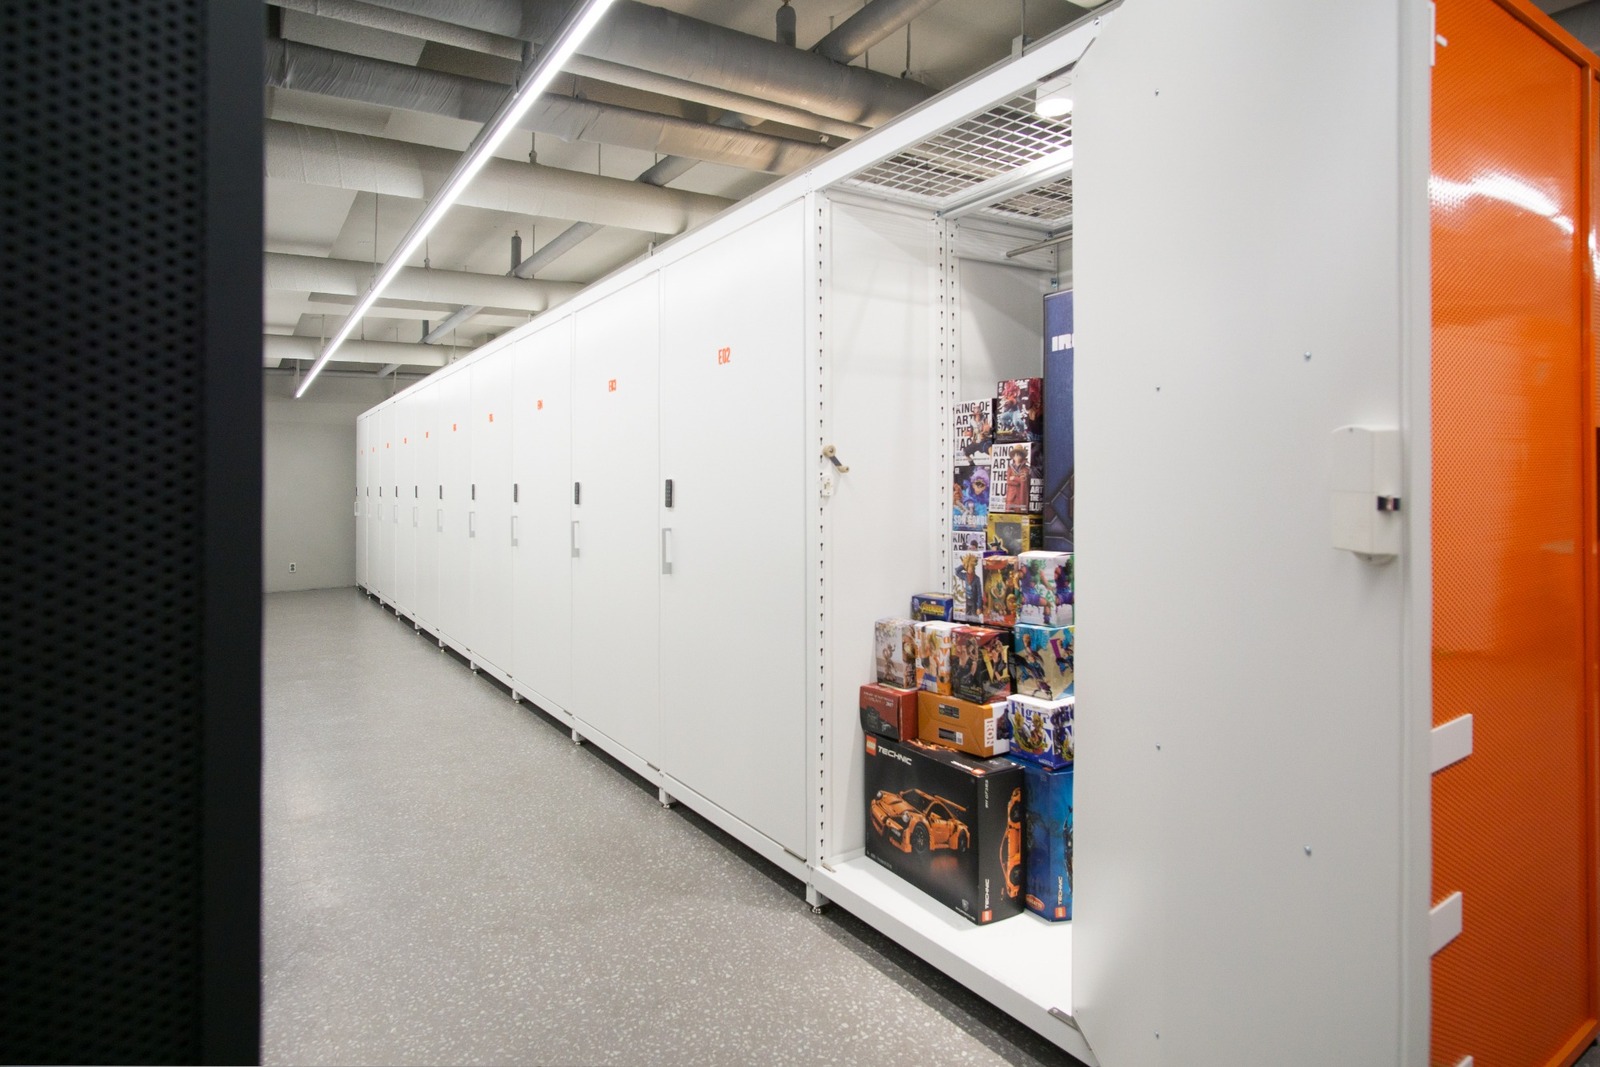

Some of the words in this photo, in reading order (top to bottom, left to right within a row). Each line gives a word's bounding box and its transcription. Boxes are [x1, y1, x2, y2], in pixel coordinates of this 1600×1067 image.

[1052, 333, 1073, 352] IR
[718, 347, 731, 365] E02
[993, 471, 1007, 481] THE
[878, 745, 912, 766] TECHNIC
